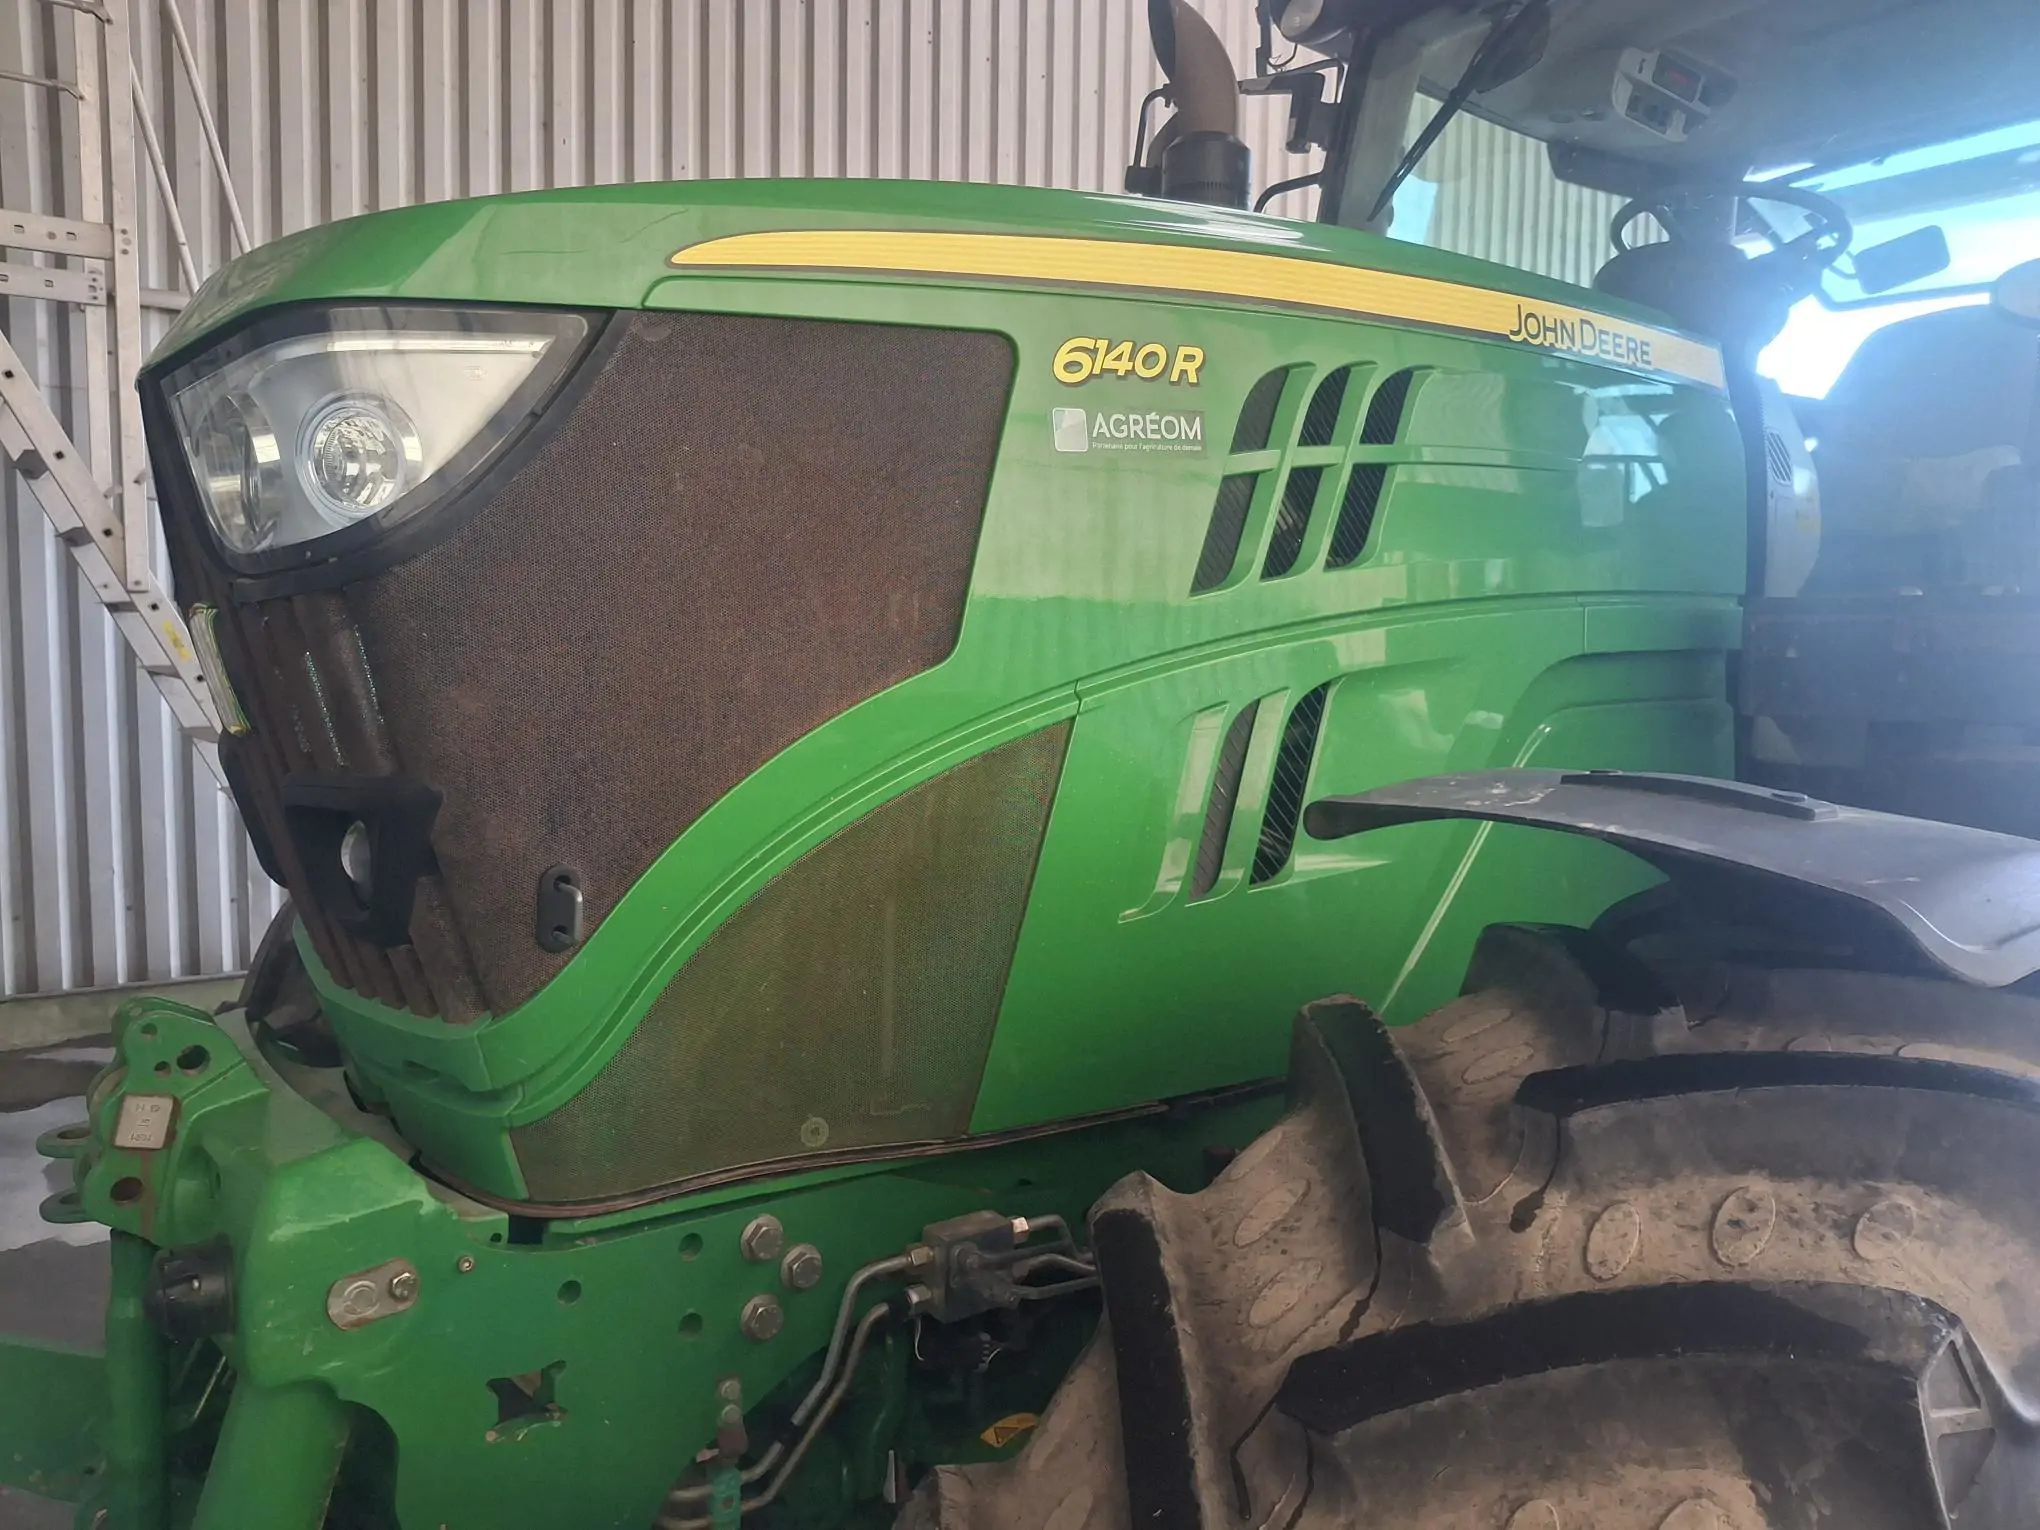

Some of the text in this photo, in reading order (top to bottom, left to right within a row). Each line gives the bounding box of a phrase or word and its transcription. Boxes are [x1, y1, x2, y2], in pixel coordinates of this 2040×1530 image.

[1510, 303, 1652, 366] JOHN DEERE
[1092, 411, 1202, 441] AGRÉOM
